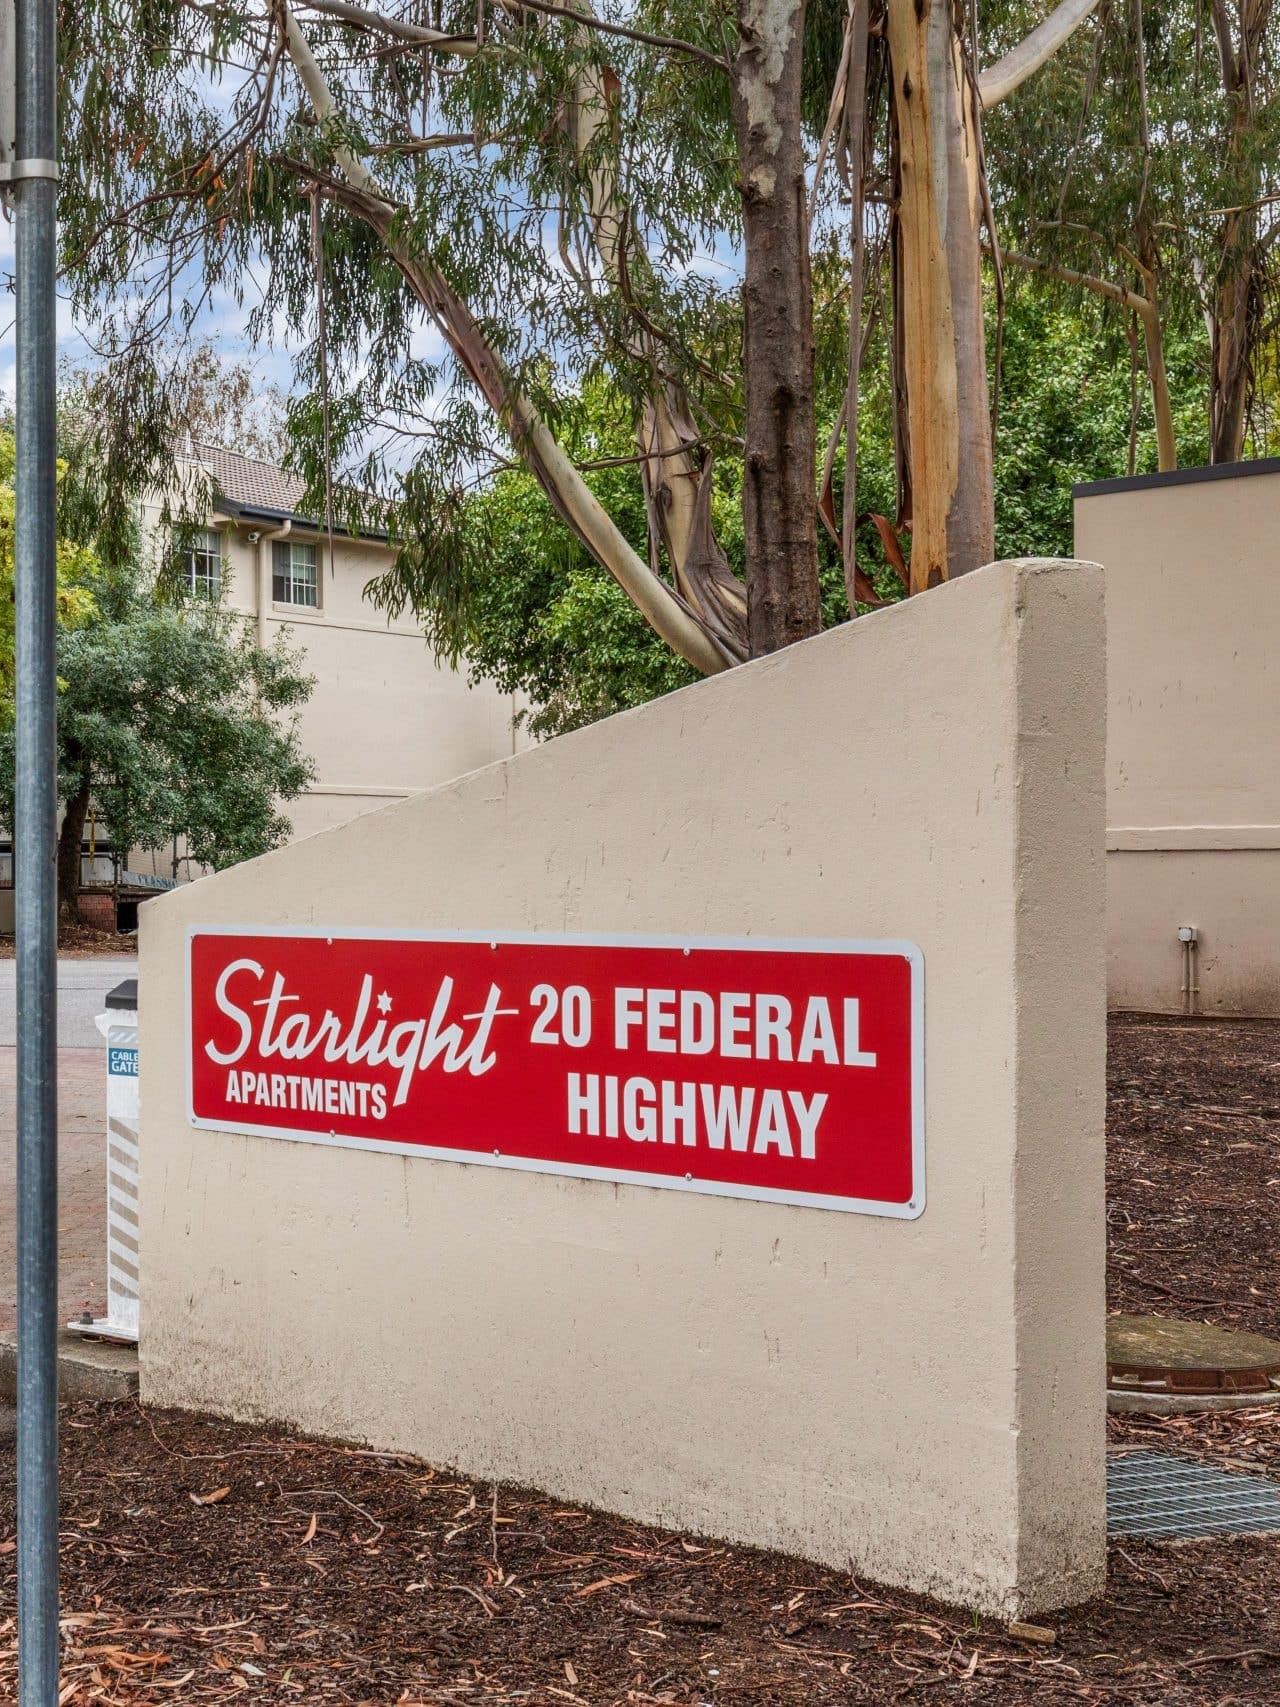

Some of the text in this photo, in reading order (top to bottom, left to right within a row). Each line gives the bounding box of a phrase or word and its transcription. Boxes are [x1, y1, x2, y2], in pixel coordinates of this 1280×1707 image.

[205, 958, 877, 1106] Starlight 20 FEDERAL
[226, 1070, 829, 1159] APARTMENTS HIGHWAY
